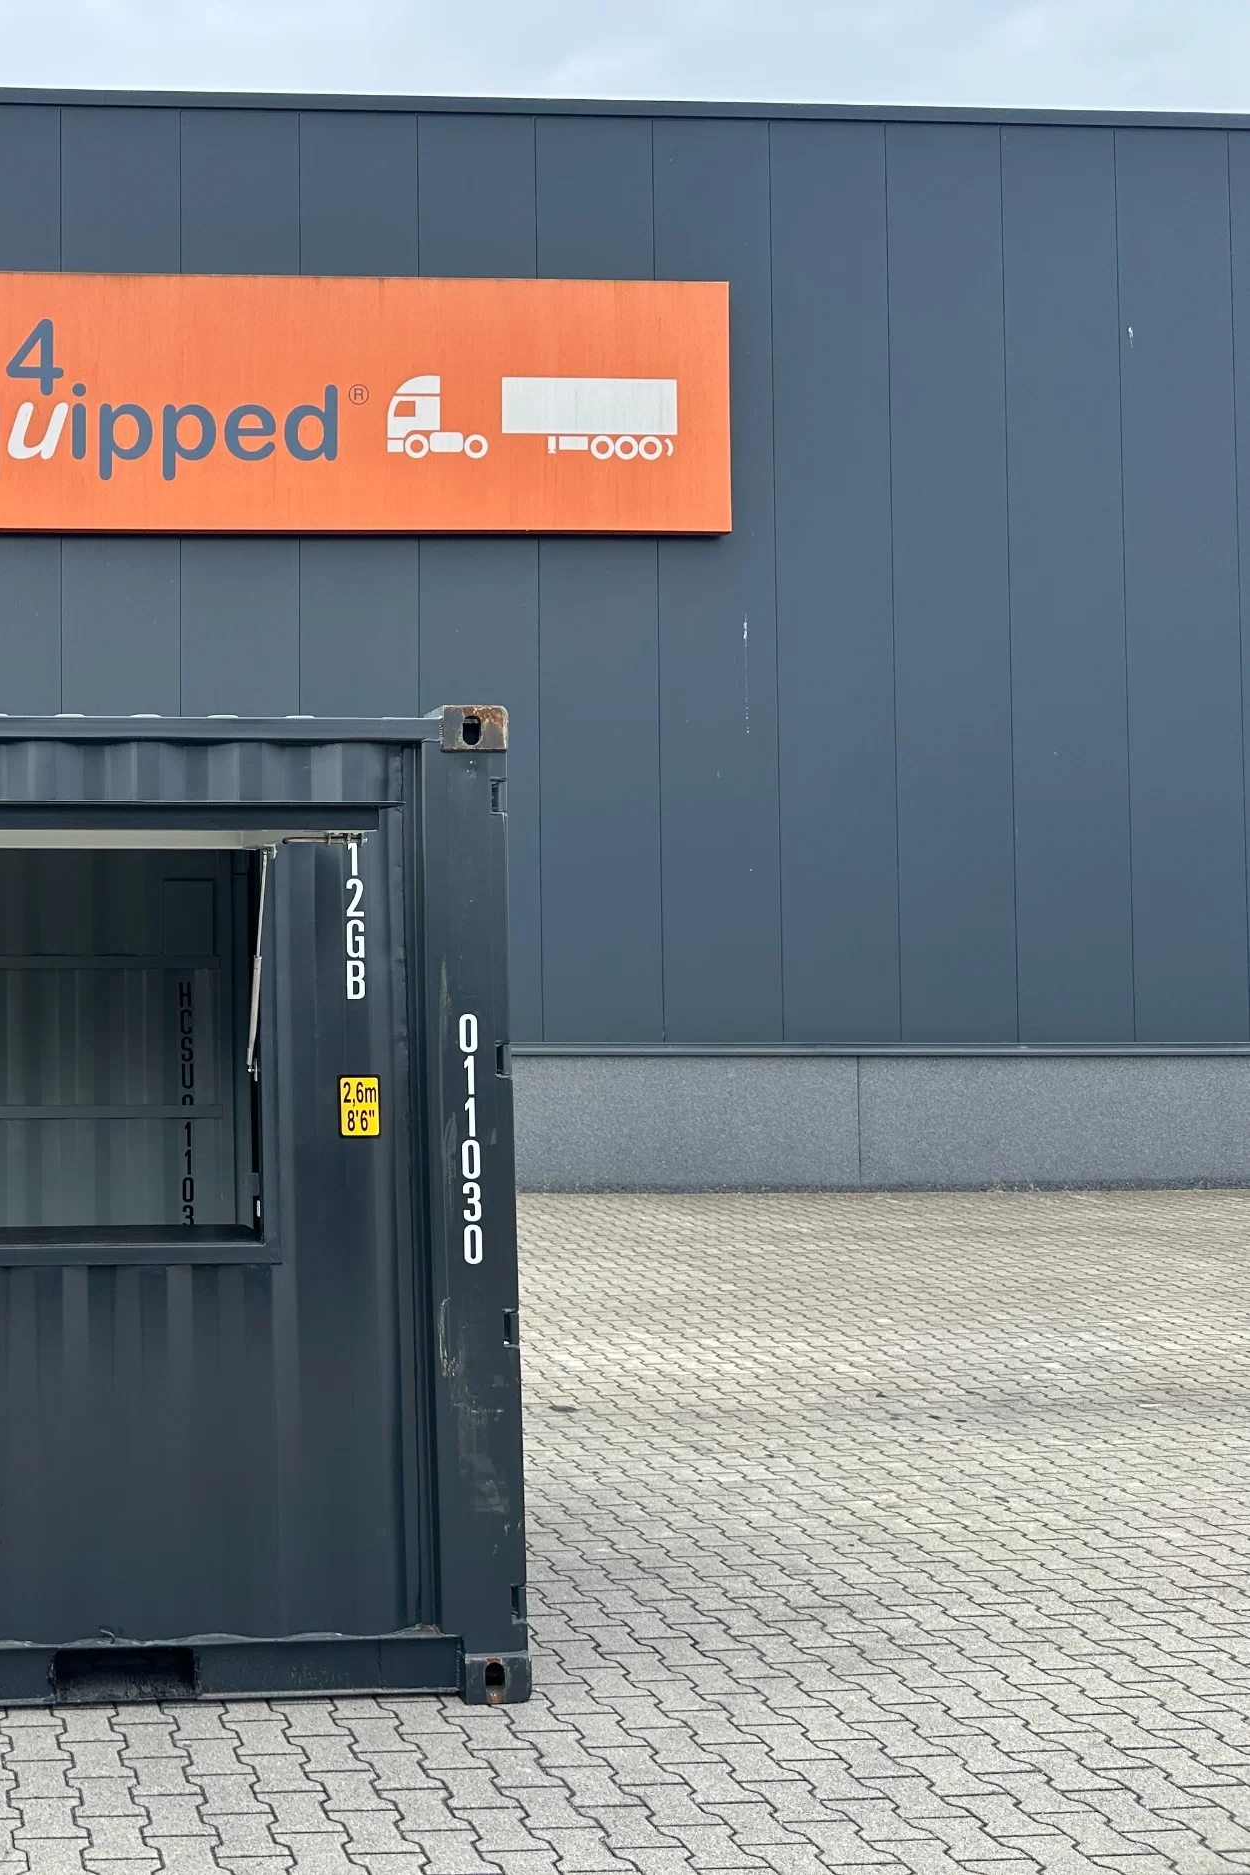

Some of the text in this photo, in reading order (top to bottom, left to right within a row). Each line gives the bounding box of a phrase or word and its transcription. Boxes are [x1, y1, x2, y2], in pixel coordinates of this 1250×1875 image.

[6, 318, 64, 396] 4
[343, 1081, 377, 1107] 2,6m
[347, 1109, 375, 1132] 8'6"
[459, 1013, 483, 1264] 011030
